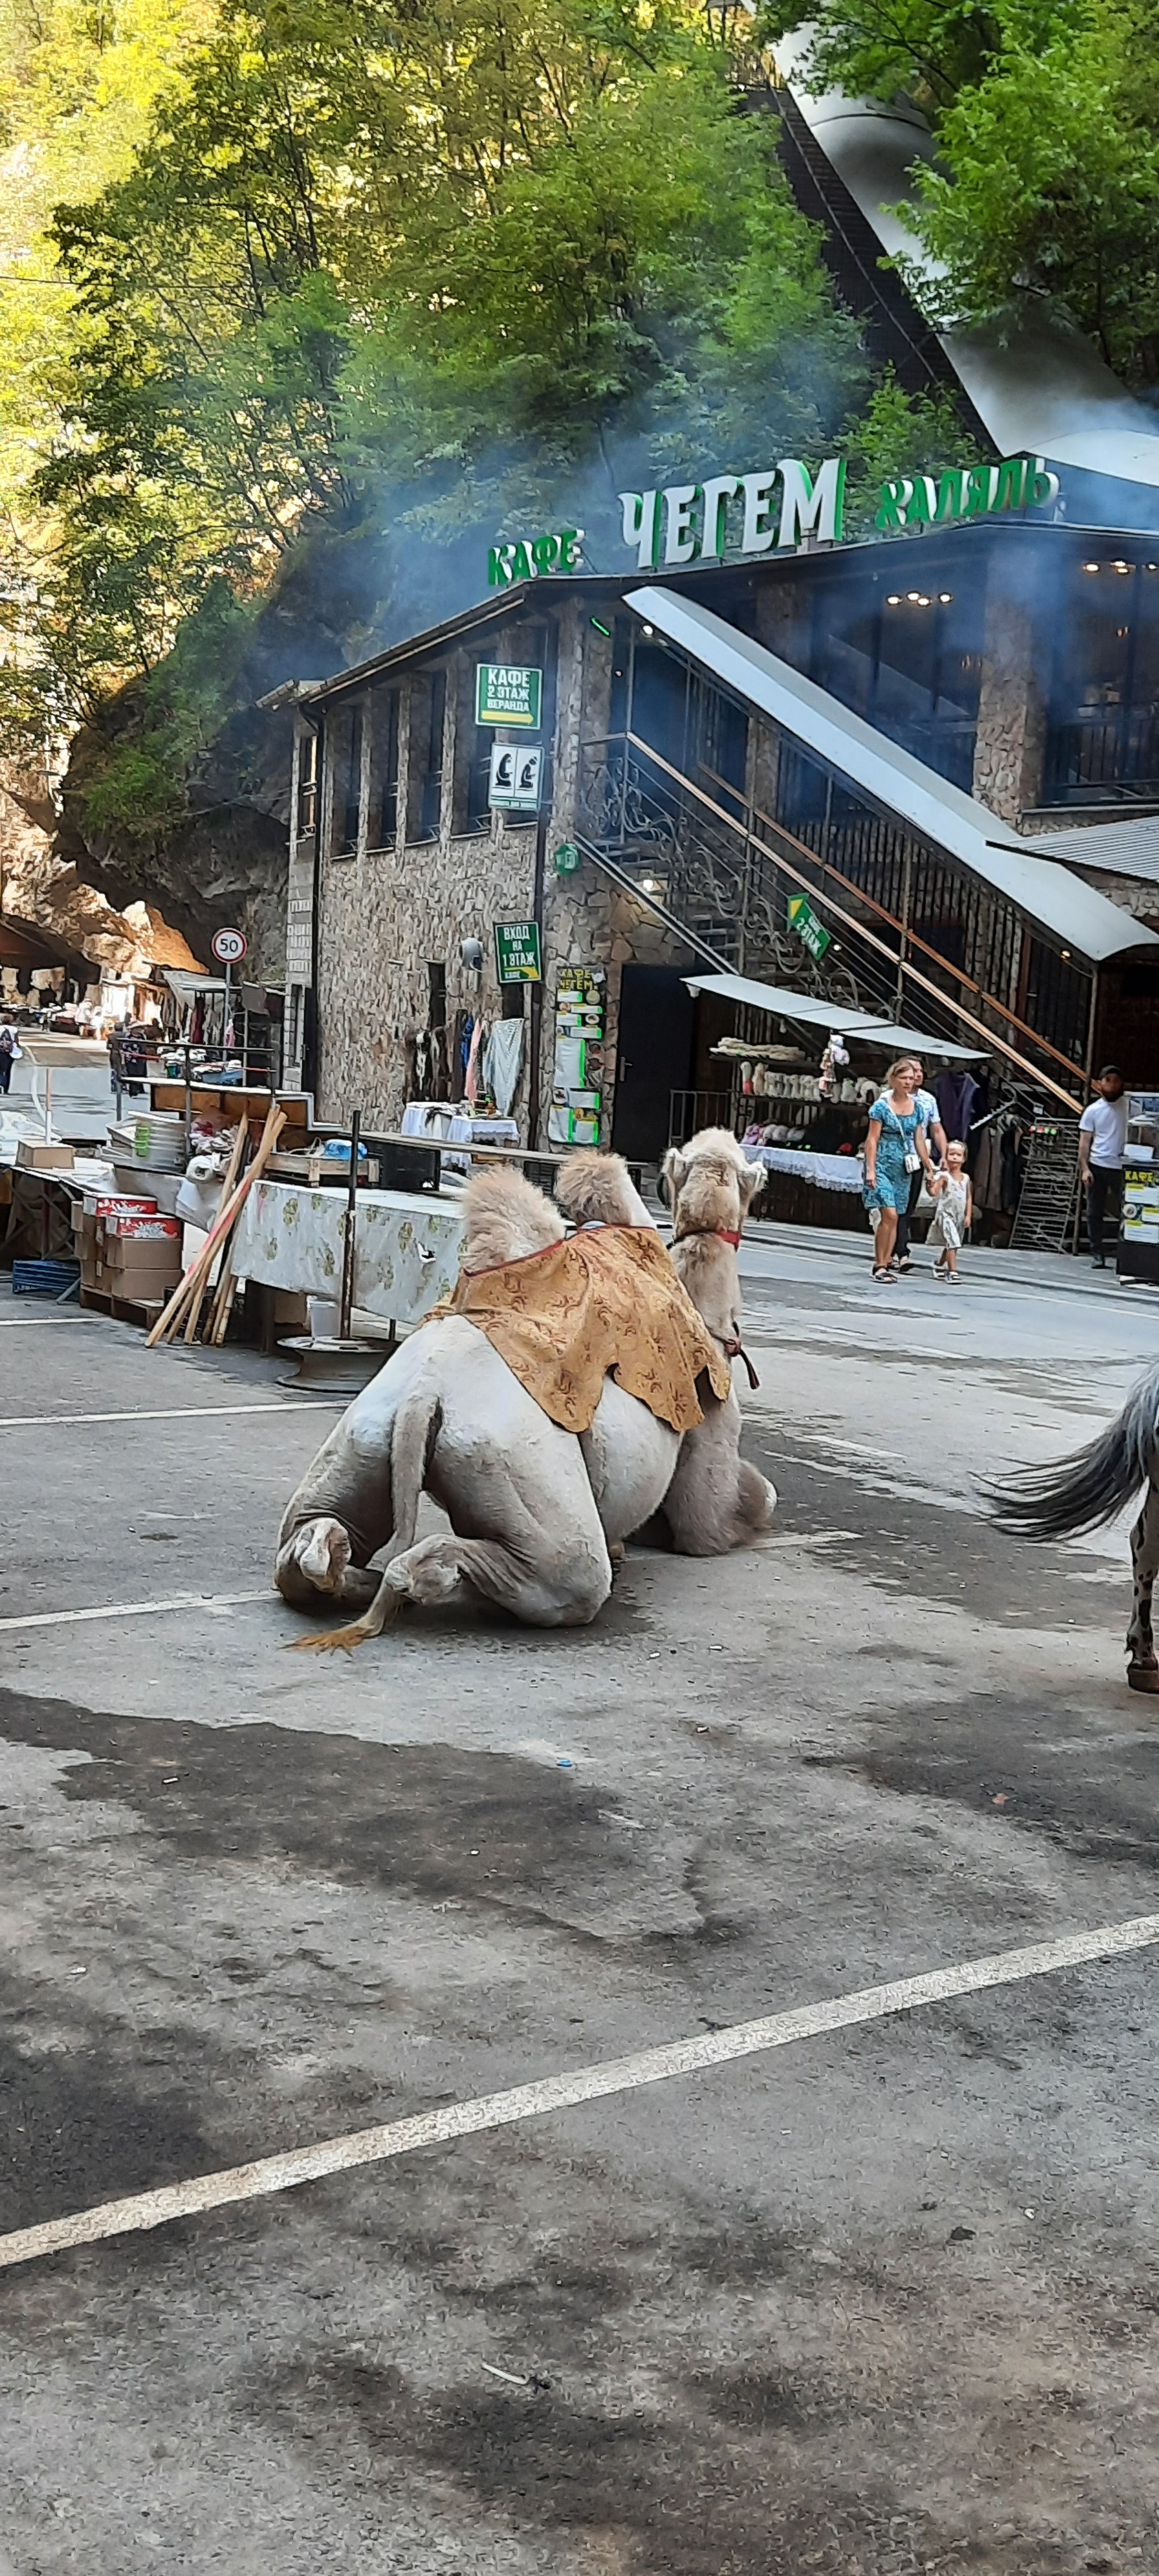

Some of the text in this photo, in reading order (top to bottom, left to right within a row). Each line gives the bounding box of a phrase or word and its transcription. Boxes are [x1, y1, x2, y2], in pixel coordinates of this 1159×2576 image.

[489, 458, 1060, 585] КАФЕ ЧЕГЕМ ХАЛЯЛЬ
[488, 668, 531, 688] КАФЕ
[487, 685, 529, 701] 2 ЭТАЖ
[487, 699, 530, 712] ВЕРАНДА
[796, 917, 805, 931] 2
[503, 925, 530, 941] ВХОД
[220, 938, 238, 952] 50
[512, 940, 523, 951] НА
[503, 952, 536, 967] 1 ЭТАЖ
[1125, 1170, 1153, 1182] КАФЕ
